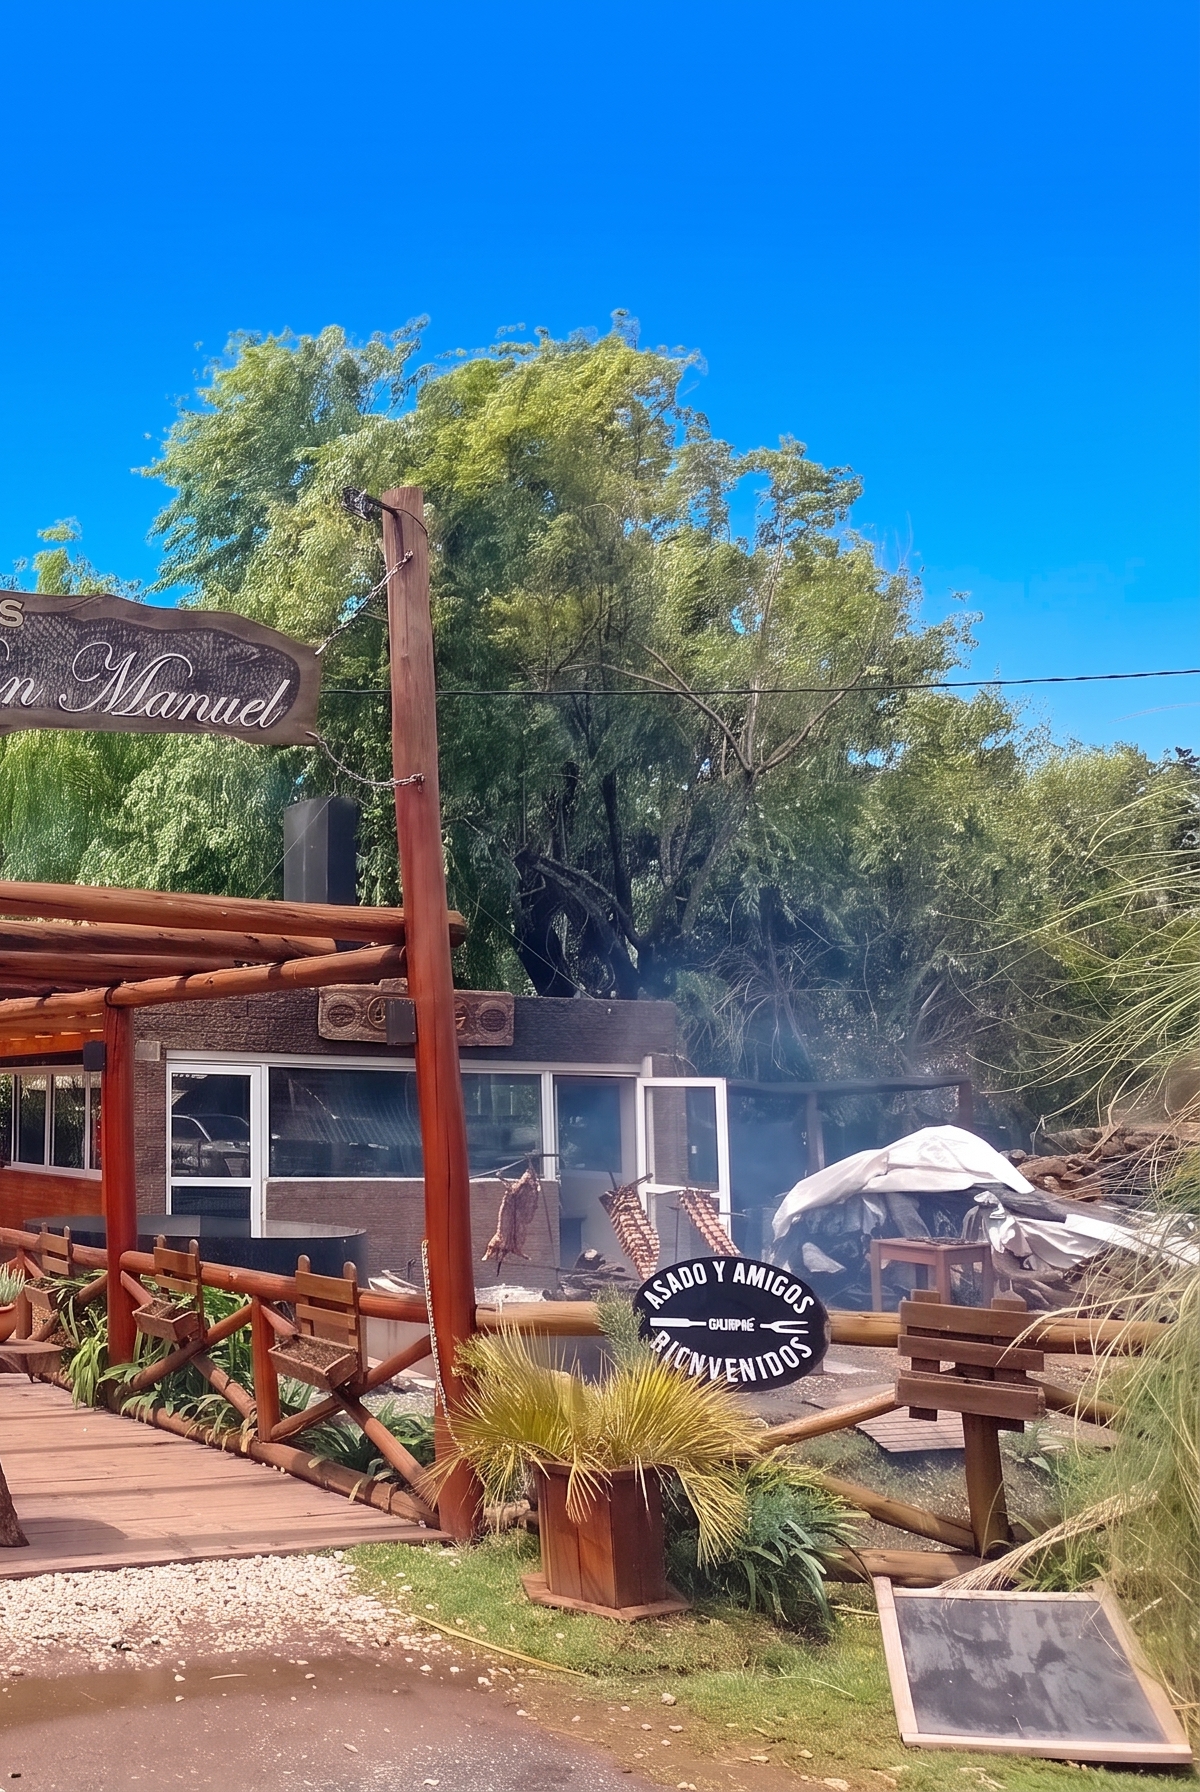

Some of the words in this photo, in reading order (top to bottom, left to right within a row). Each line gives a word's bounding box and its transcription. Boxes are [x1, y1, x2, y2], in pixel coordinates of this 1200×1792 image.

[59, 641, 291, 728] Manuel
[643, 1262, 708, 1310] ASADO
[711, 1260, 726, 1283] Y
[732, 1262, 815, 1314] AMIGOS
